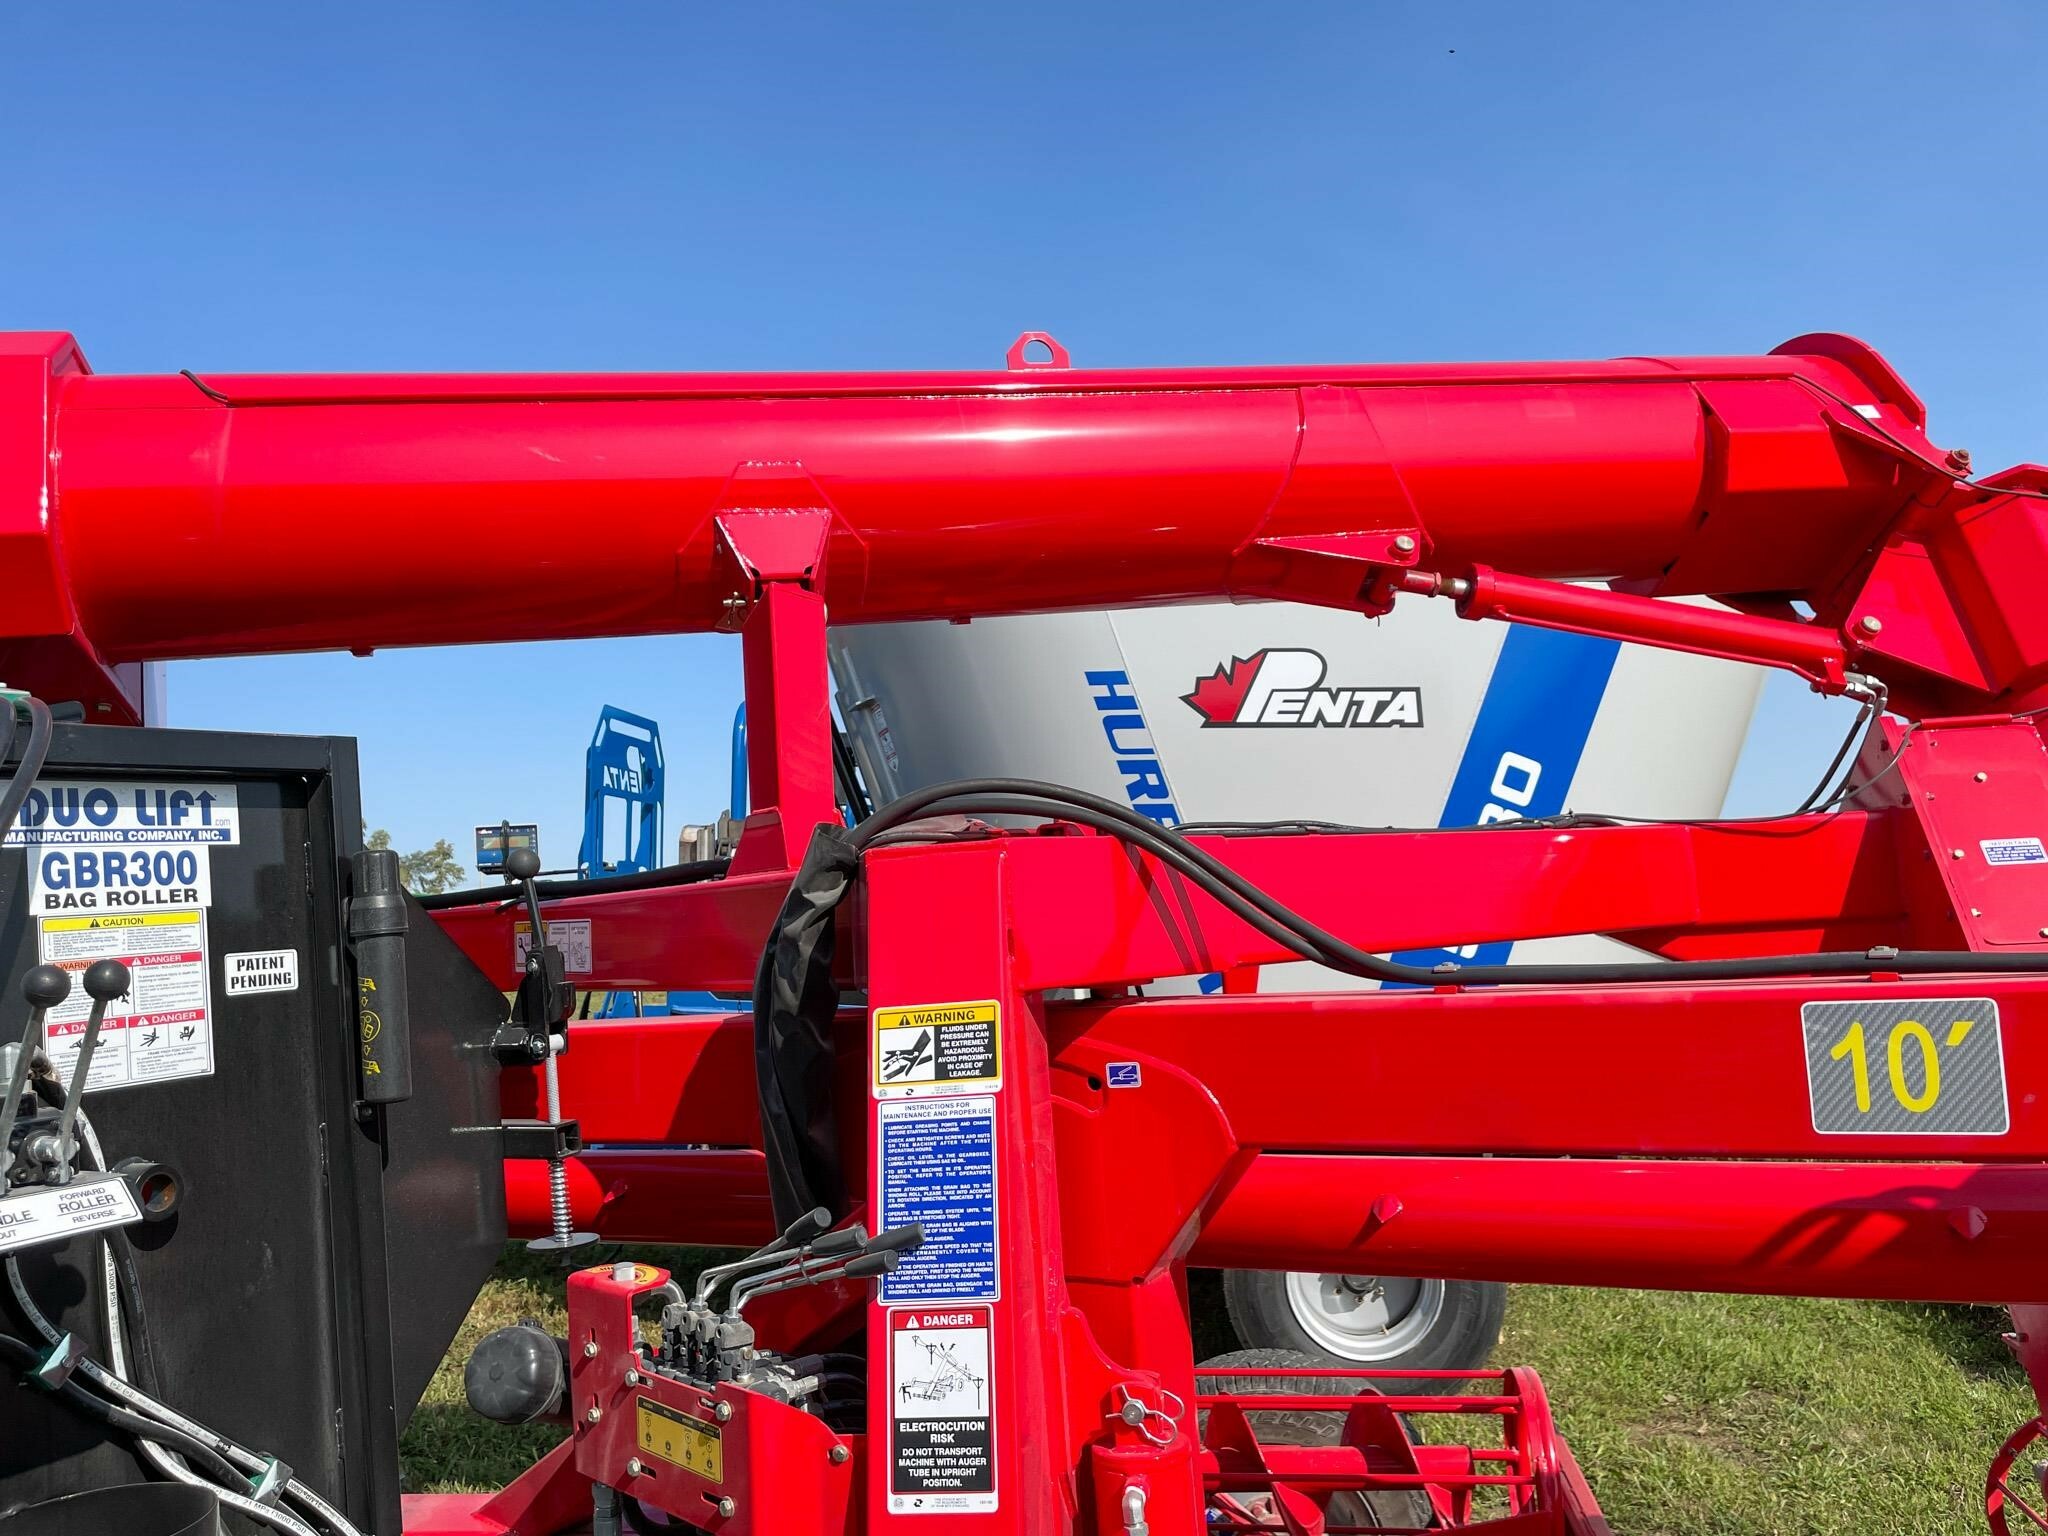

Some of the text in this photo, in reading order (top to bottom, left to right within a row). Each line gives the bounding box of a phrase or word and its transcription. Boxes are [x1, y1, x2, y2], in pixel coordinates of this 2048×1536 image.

[1235, 650, 1421, 724] PENTA
[19, 788, 118, 826] DUO
[135, 790, 216, 826] LIFT
[4, 830, 223, 842] MANUFACTURING COMPANY, INC.
[42, 850, 198, 890] GBR300
[45, 888, 198, 910] BAG ROLLER
[103, 917, 144, 926] CAUTION
[144, 954, 182, 964] DANGER
[237, 956, 285, 972] PATENT
[60, 961, 96, 970] WARNIN
[231, 972, 292, 989] PENDING
[152, 1012, 196, 1024] DANGER
[914, 1010, 975, 1024] WARNING
[72, 1020, 118, 1034] DAER
[884, 1111, 931, 1119] MAINTENANCE
[59, 1188, 106, 1200] FORWARD
[58, 1194, 117, 1213] ROLLER
[72, 1209, 116, 1223] REVERSE
[924, 1314, 974, 1326] DANGER
[900, 1421, 985, 1432] ELECTROCUTION
[930, 1434, 955, 1444] RISK
[934, 1447, 983, 1455] TRANSPORT
[958, 1458, 986, 1466] AUGER
[942, 1468, 977, 1476] UPRIGHT
[923, 1479, 962, 1487] POSITION.
